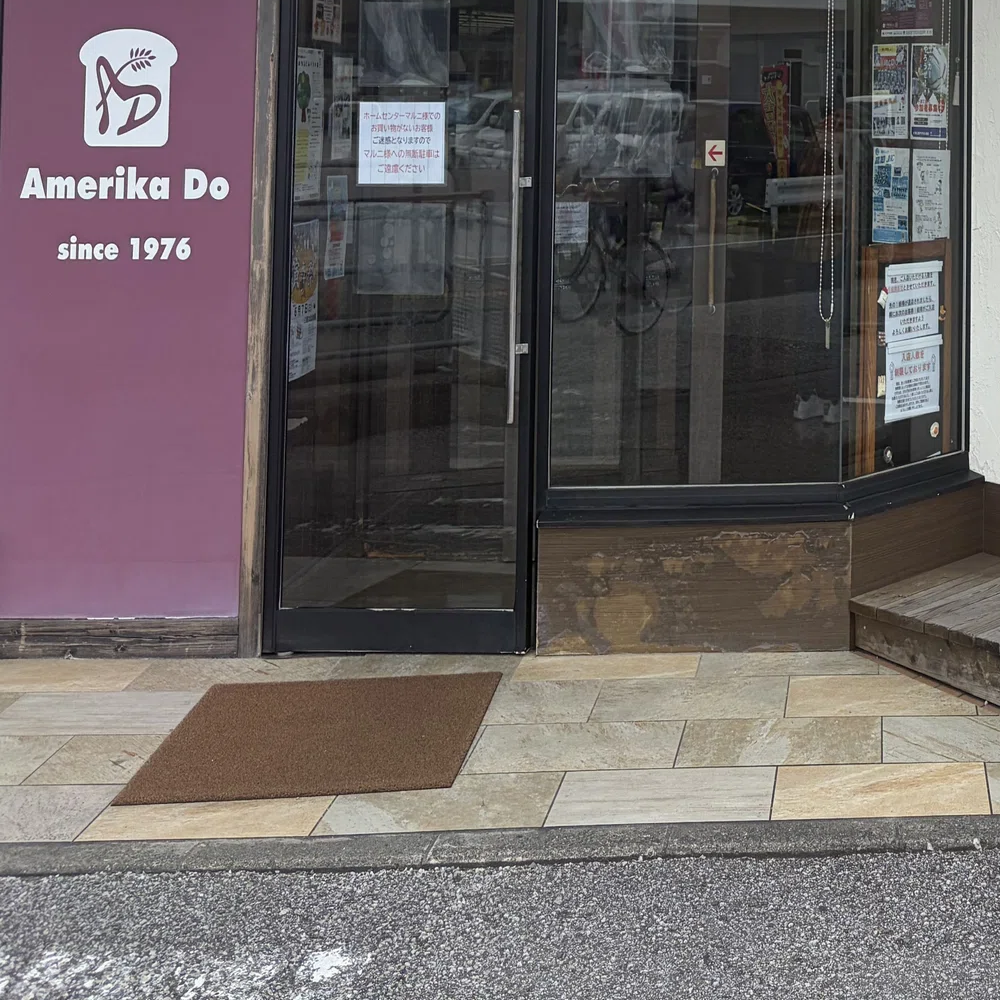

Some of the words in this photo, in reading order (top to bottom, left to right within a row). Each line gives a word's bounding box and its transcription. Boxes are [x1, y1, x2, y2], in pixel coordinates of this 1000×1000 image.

[377, 163, 426, 174] ご遠慮ください
[19, 165, 170, 201] Amerika
[183, 168, 230, 201] Do
[57, 235, 119, 261] since
[130, 237, 192, 261] 1976
